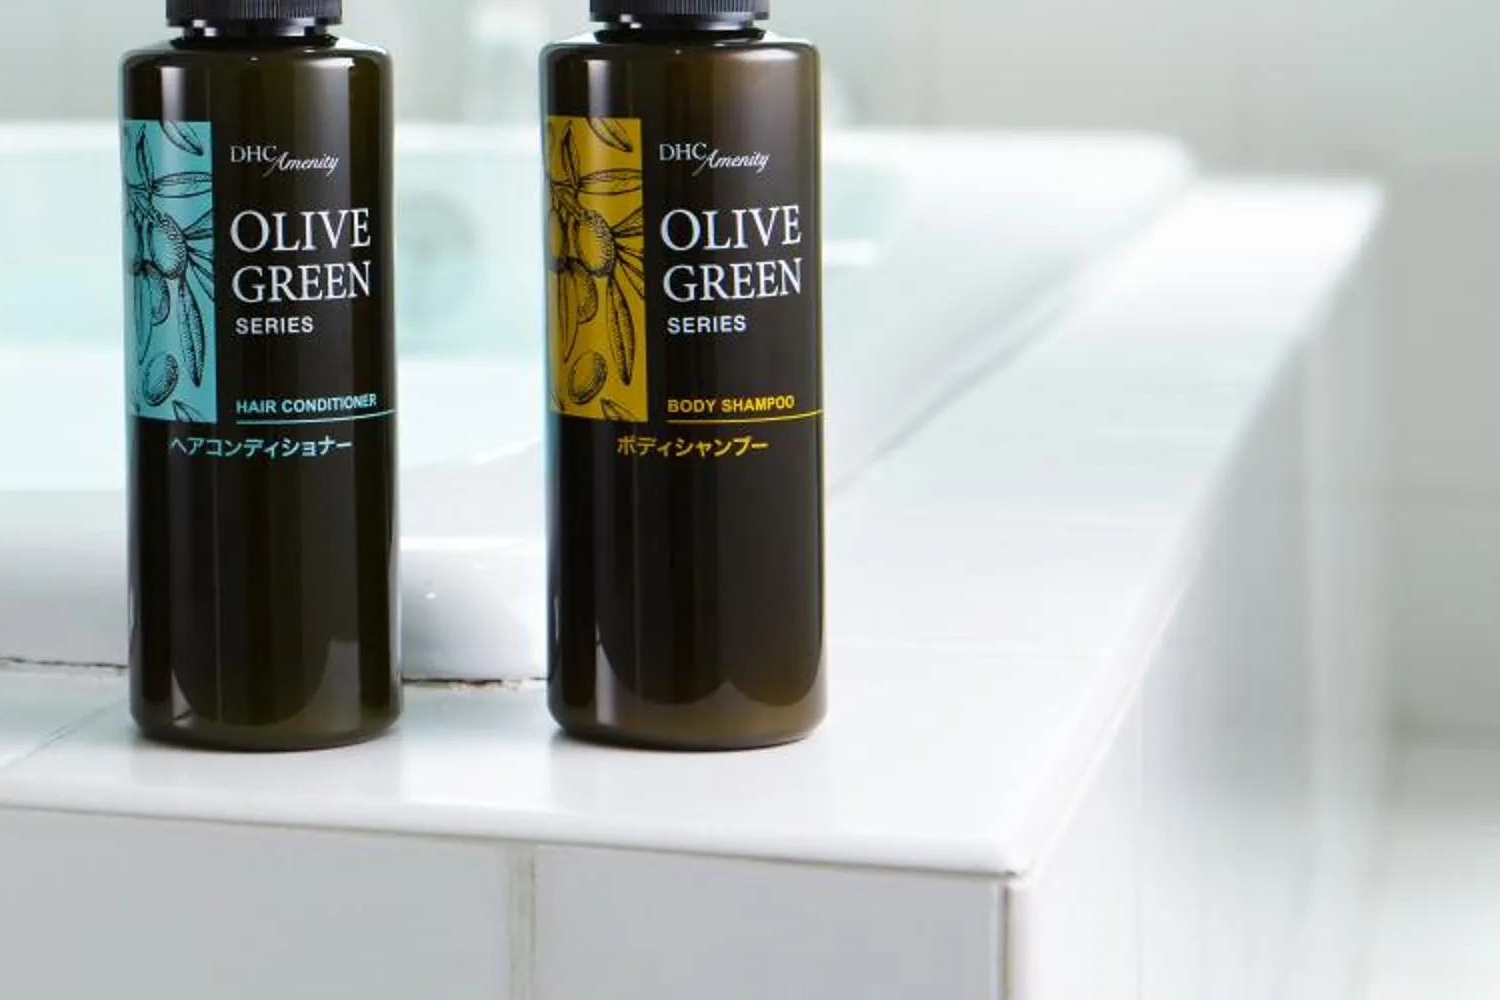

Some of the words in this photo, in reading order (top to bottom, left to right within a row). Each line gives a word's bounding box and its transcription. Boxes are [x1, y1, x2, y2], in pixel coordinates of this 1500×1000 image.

[230, 145, 276, 163] DHC
[265, 152, 339, 177] Amenity
[659, 143, 707, 161] DHC
[694, 150, 770, 175] Amenity
[231, 208, 371, 253] OLIVE
[661, 204, 802, 252] OLIVE
[232, 261, 371, 303] GREEN
[663, 258, 802, 302] GREEN
[236, 317, 314, 334] SERIES
[667, 315, 747, 334] SERIES
[236, 400, 276, 413] HAIR
[282, 394, 377, 413] CONDITIONER
[668, 399, 716, 413] BODY
[721, 396, 795, 412] SHAMPOO
[168, 436, 353, 458] ヘアコンディショナー
[617, 435, 769, 457] ボディシャンプー
